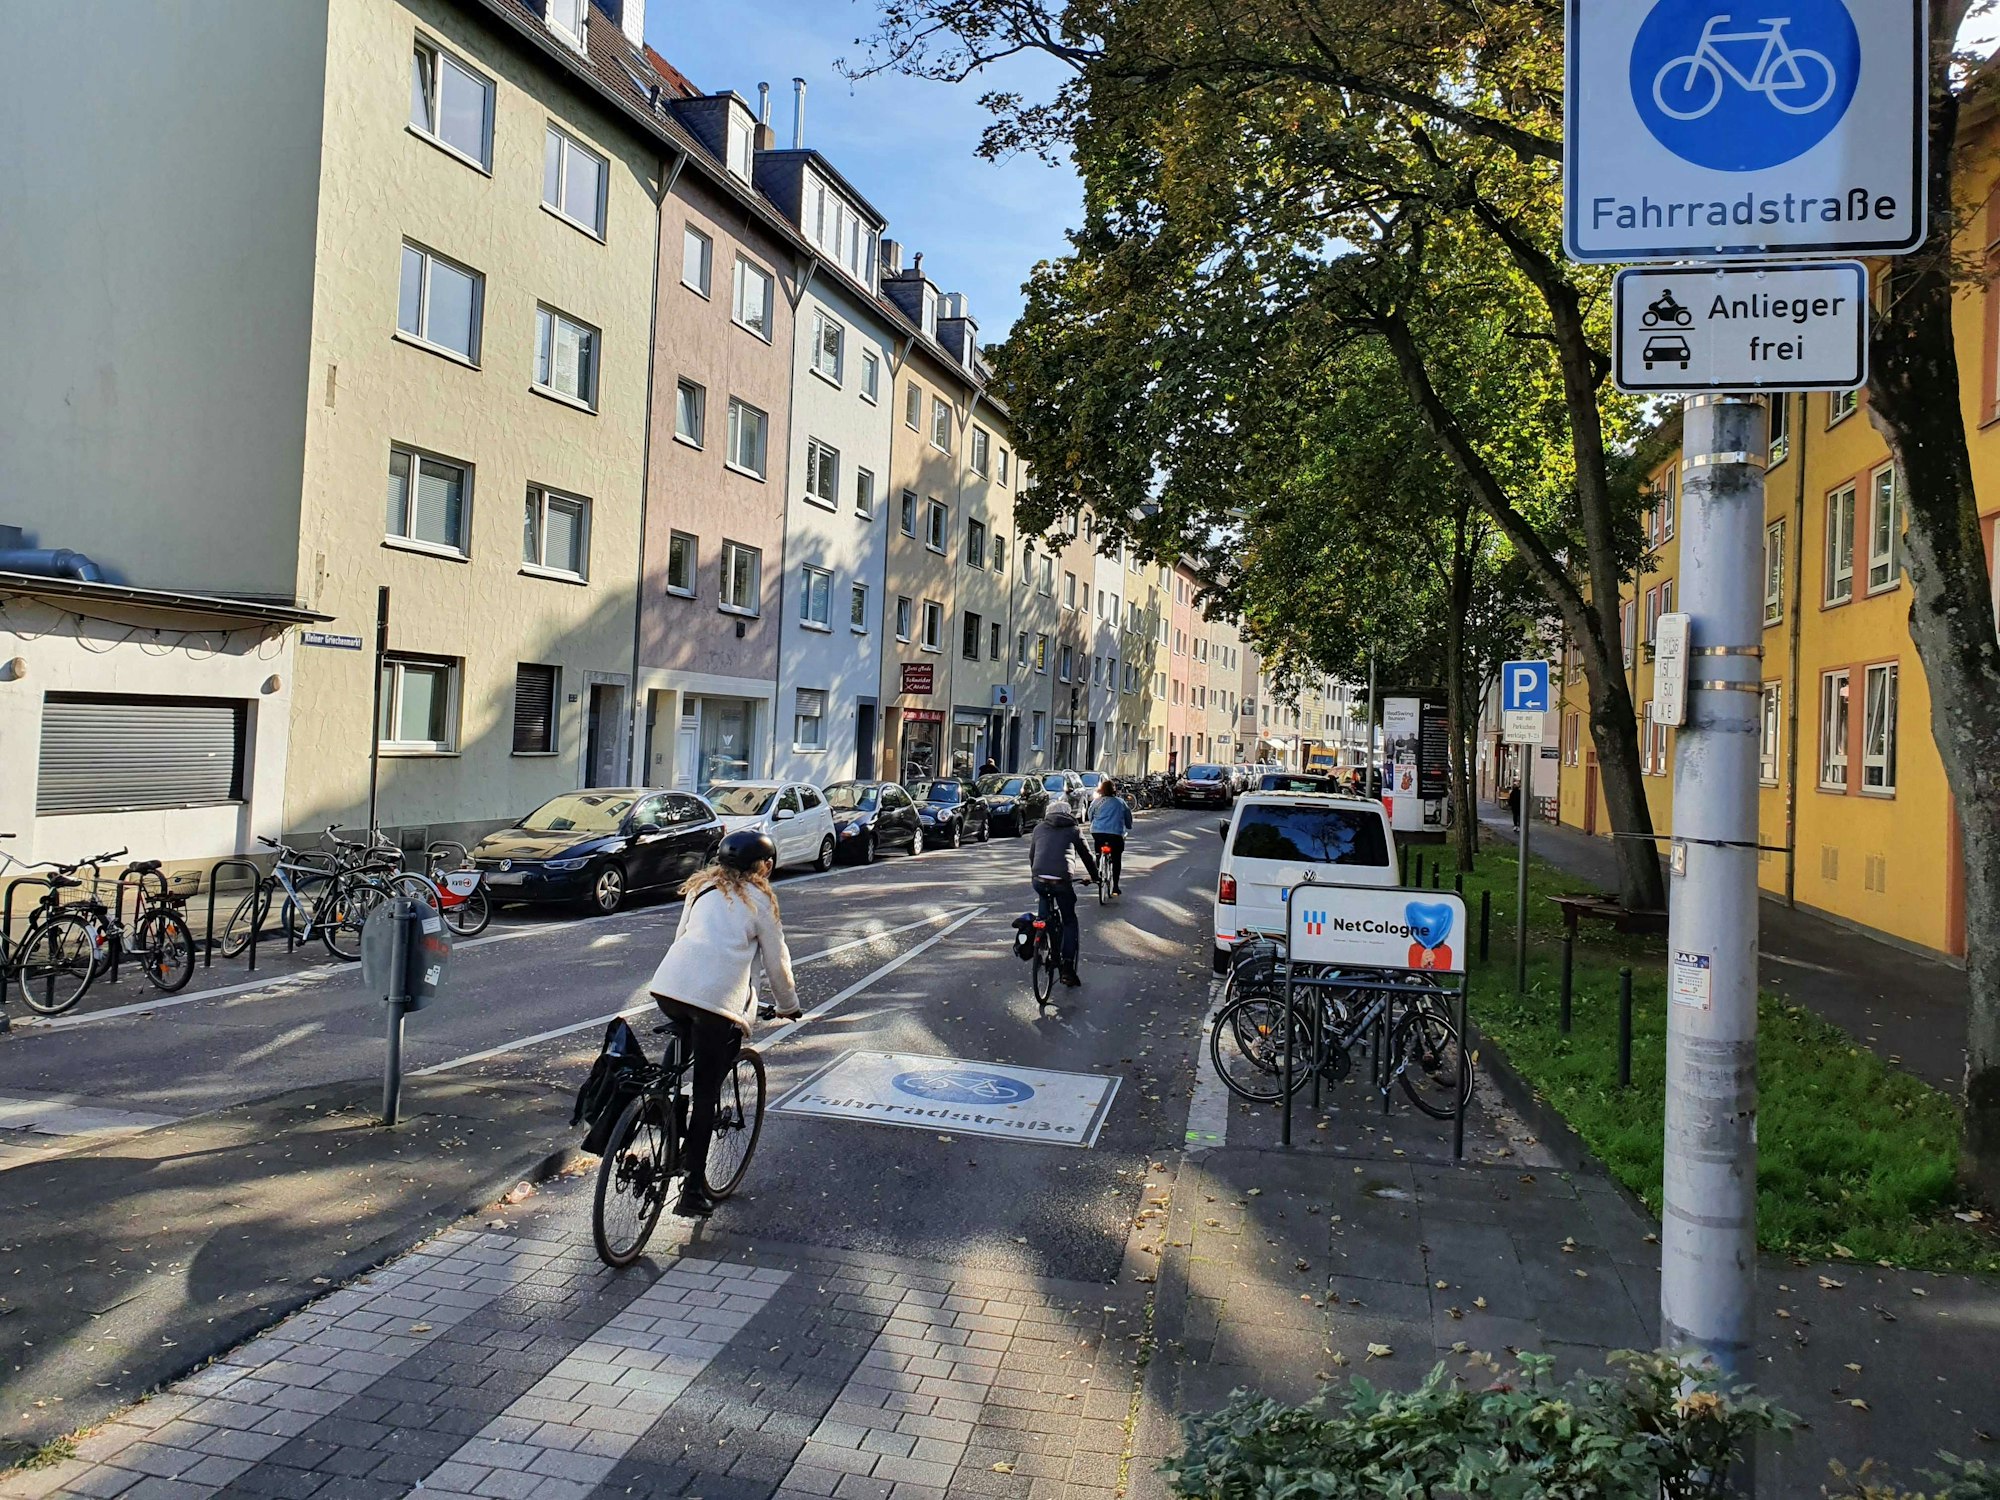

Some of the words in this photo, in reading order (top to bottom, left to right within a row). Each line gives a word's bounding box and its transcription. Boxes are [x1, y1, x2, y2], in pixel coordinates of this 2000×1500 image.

[1592, 187, 1897, 230] Fahrradstraße
[1708, 293, 1846, 324] Anlieger
[1749, 336, 1804, 361] frei
[304, 633, 324, 644] Kleiner
[1513, 668, 1538, 708] P
[1333, 917, 1430, 939] NetCologne
[1674, 952, 1698, 963] RAD
[798, 1094, 1076, 1134] Fahrradstraße
